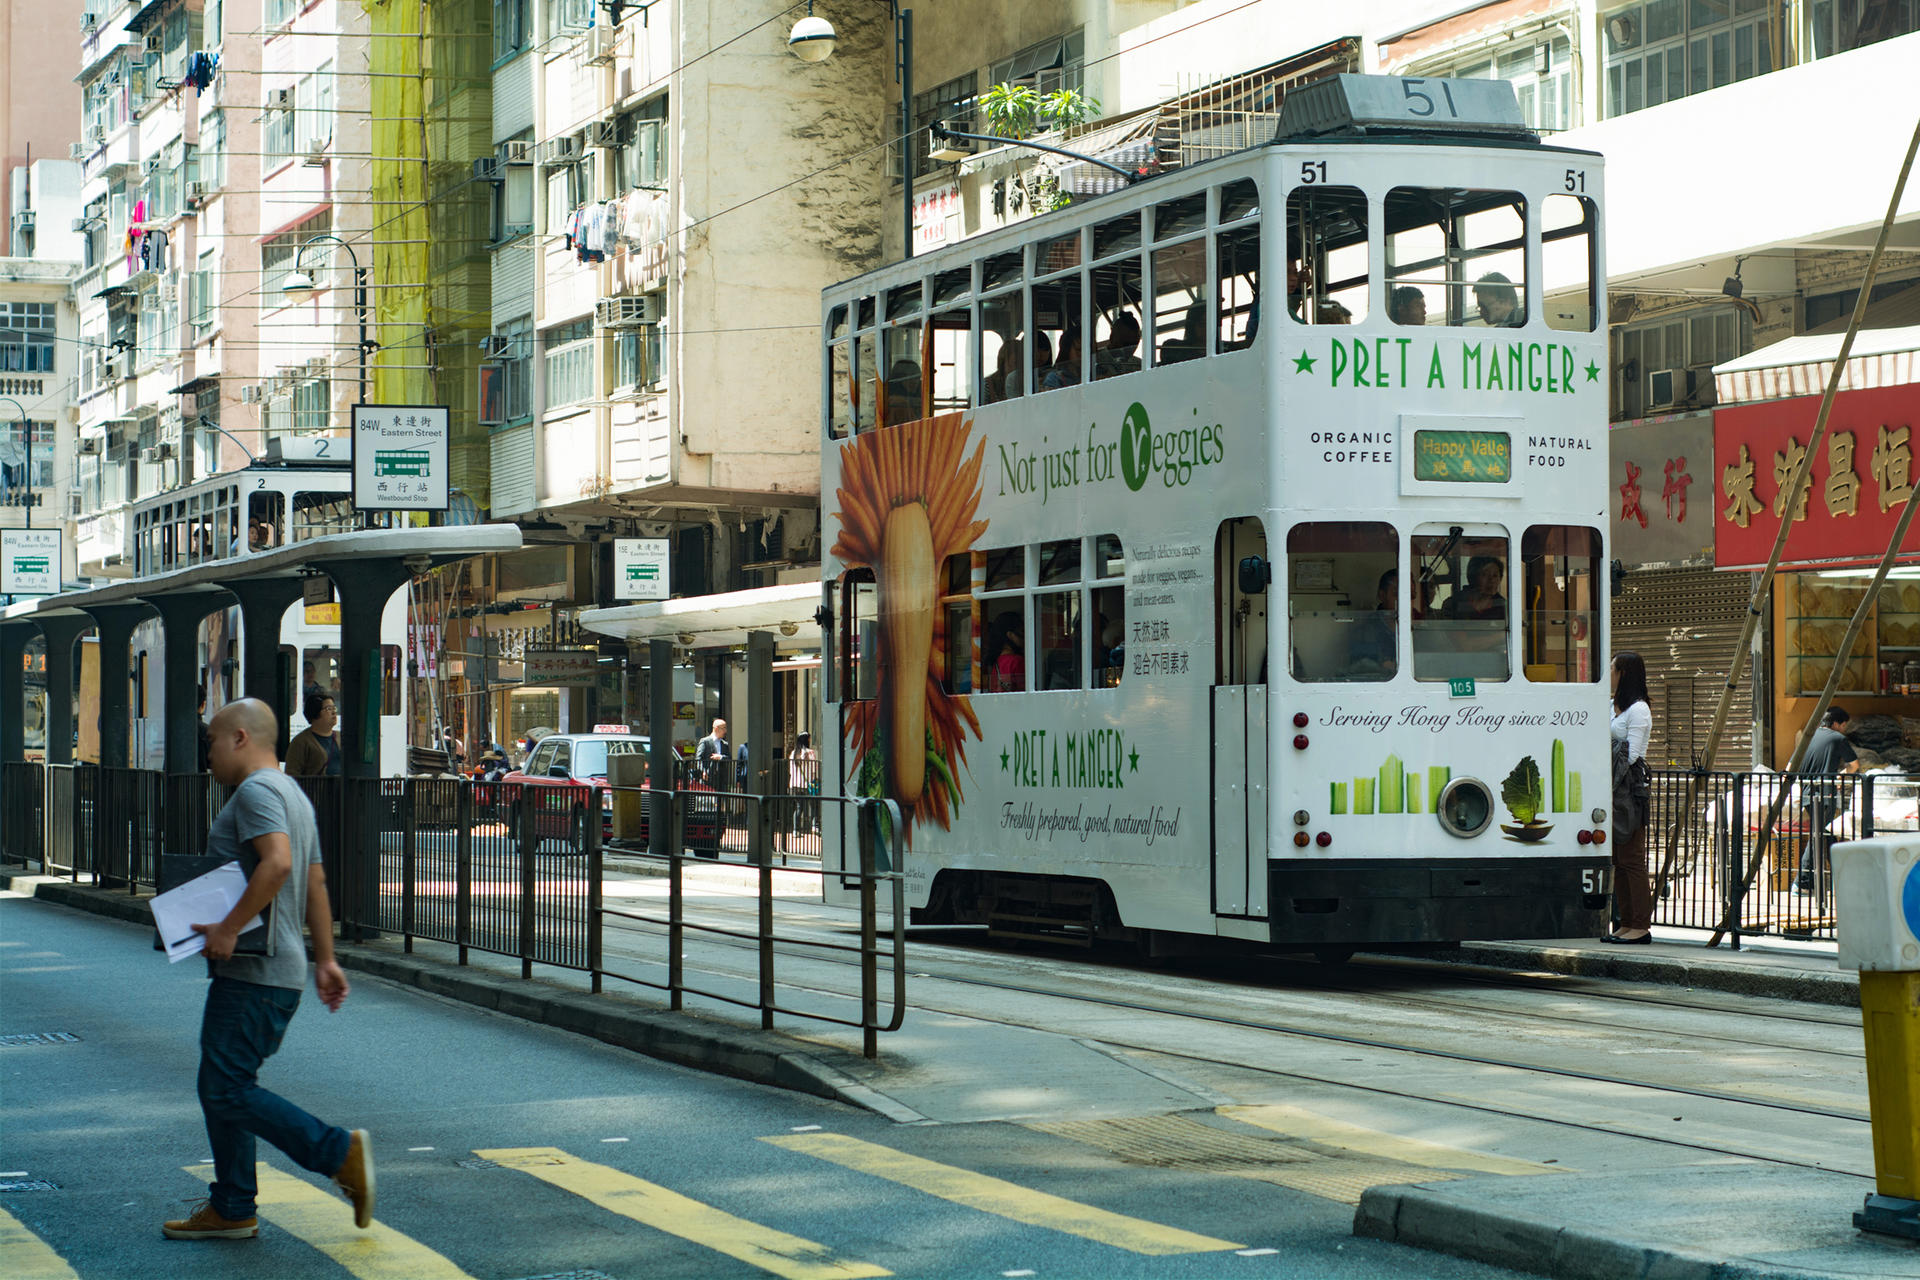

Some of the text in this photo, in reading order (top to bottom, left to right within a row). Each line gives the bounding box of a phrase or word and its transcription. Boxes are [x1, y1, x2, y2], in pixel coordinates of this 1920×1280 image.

[1401, 79, 1457, 118] 51
[1301, 161, 1327, 184] 51
[1564, 169, 1585, 192] 51
[1331, 337, 1412, 388] PRET
[1427, 340, 1445, 389] A
[360, 419, 380, 431] 84W
[381, 428, 442, 437] Eastern Street
[1311, 432, 1393, 444] ORGANIC
[1528, 436, 1592, 450] NATURAL
[314, 439, 331, 458] 2
[998, 401, 1224, 507] Not just for Veggies
[1423, 438, 1465, 458] Happy
[1323, 451, 1393, 463] COFFEE
[1528, 455, 1566, 467] FOOD
[257, 478, 266, 489] 2
[377, 481, 429, 493] 西行站
[377, 494, 429, 503] Westbound Stop
[1133, 592, 1143, 607] and
[1133, 620, 1170, 643] 天然滋味
[1453, 681, 1472, 693] 105
[1319, 706, 1589, 733] Serving Hong Kong since 2002
[598, 725, 627, 733] TAXI
[1014, 730, 1046, 788] PRET
[1052, 732, 1061, 788] A
[1001, 801, 1035, 841] Freshly
[1113, 805, 1155, 846] natural
[1150, 805, 1181, 840] food
[1582, 869, 1604, 894] 51
